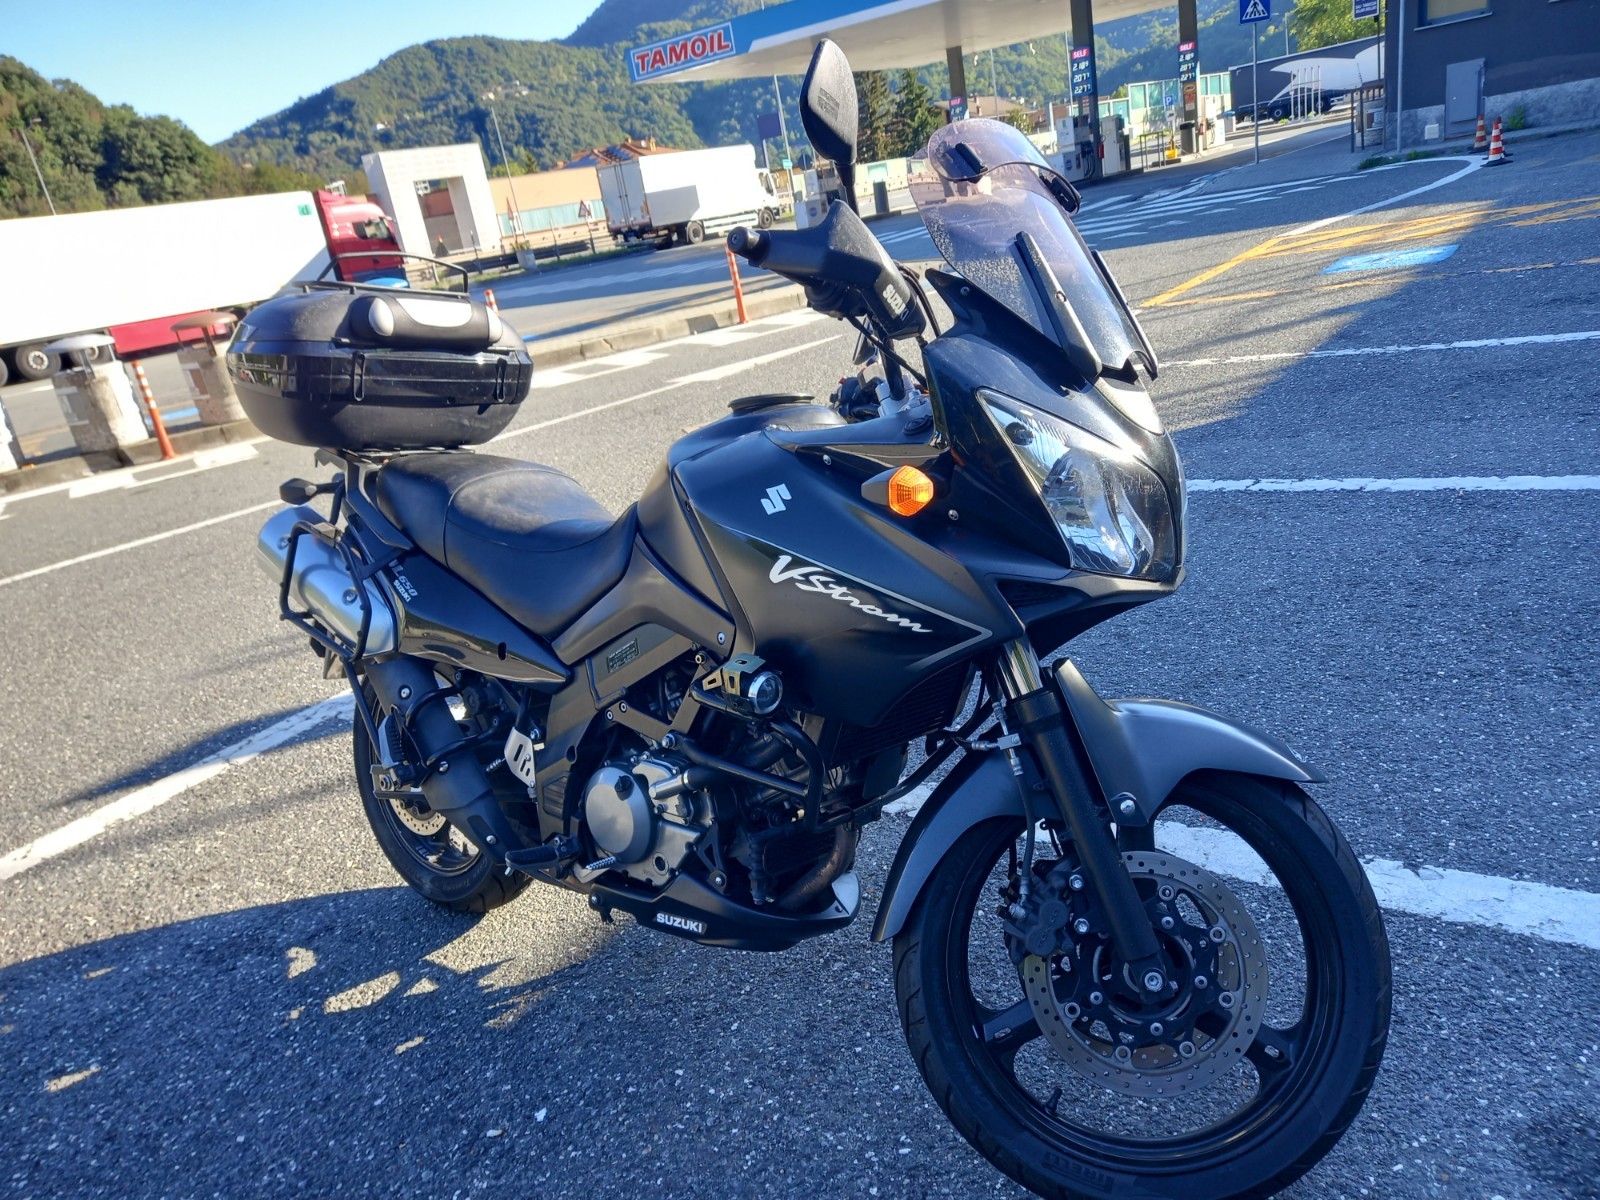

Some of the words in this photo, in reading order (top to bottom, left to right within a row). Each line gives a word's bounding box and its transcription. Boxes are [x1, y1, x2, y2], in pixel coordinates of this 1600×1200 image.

[634, 29, 732, 74] TAMOIL
[1073, 49, 1088, 59] SELF
[393, 579, 412, 603] SUZUKI
[656, 912, 703, 933] SUZUKI
